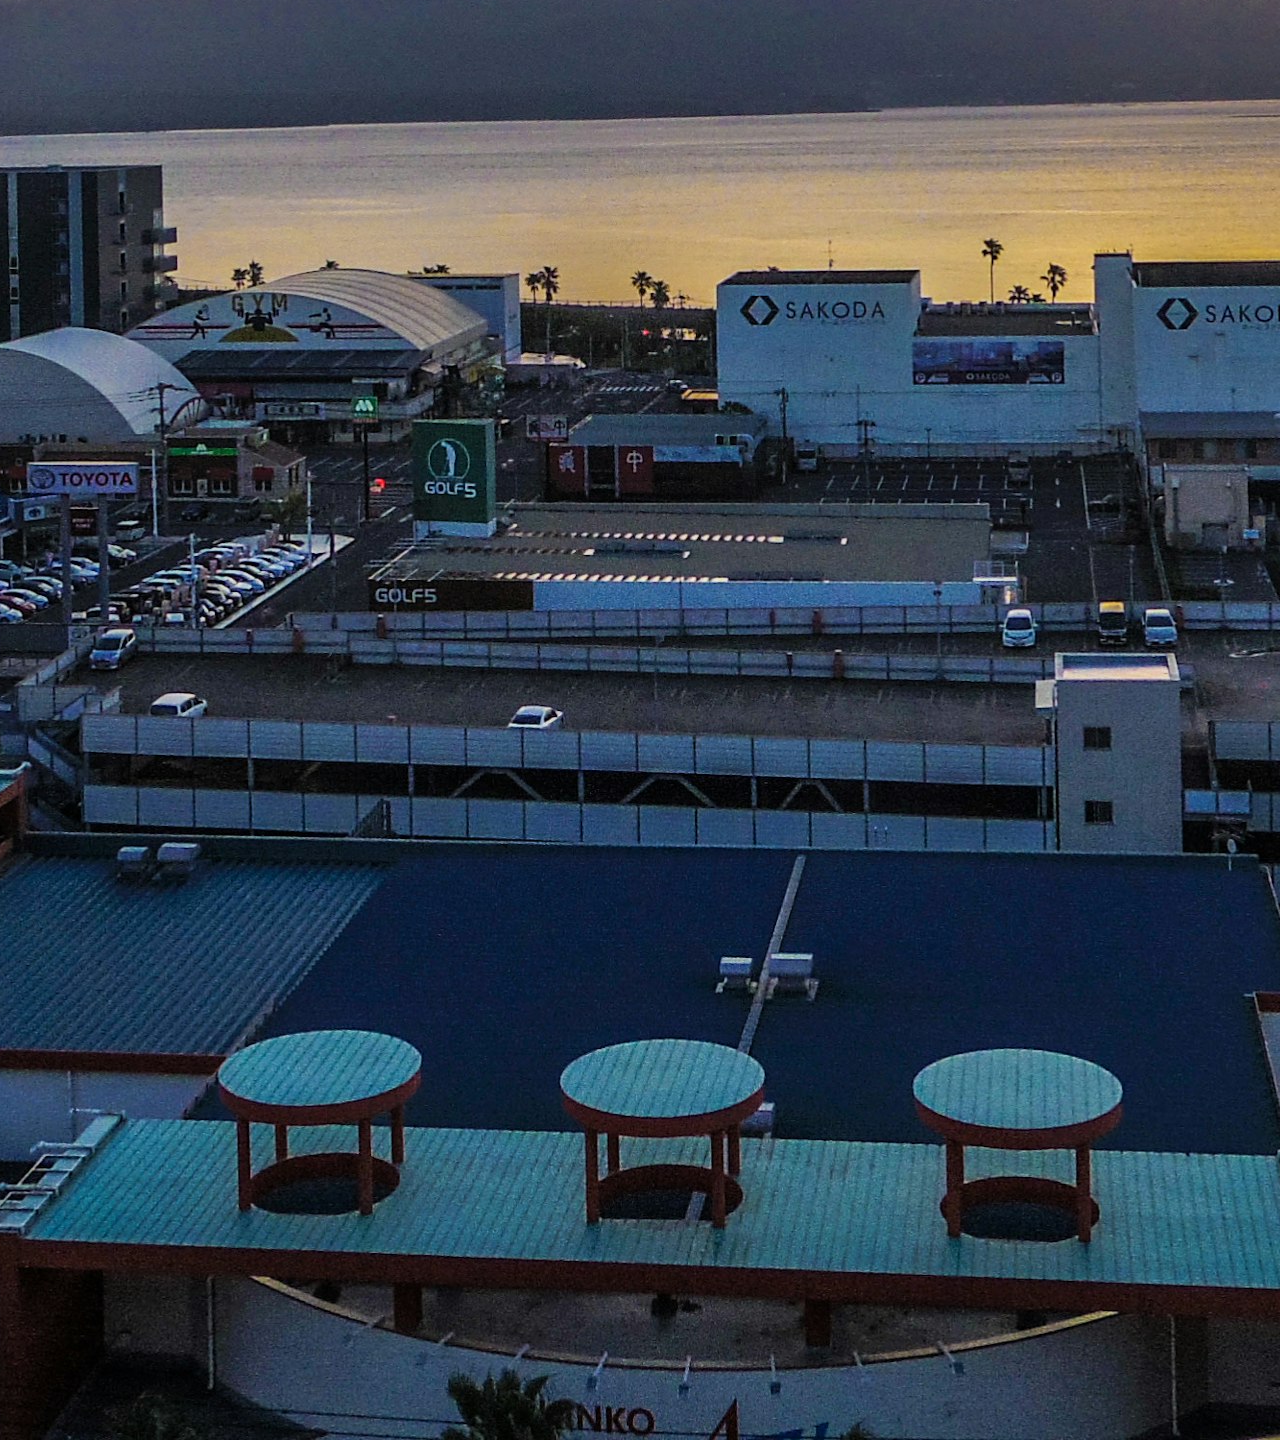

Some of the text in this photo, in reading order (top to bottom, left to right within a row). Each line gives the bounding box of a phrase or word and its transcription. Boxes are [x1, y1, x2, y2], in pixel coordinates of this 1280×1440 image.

[231, 293, 288, 312] GYM
[785, 300, 886, 319] SAKODA
[975, 373, 1011, 381] SAKODA
[59, 471, 134, 487] TOYOTA
[424, 480, 477, 499] GOLF5
[374, 587, 439, 605] GOLF5
